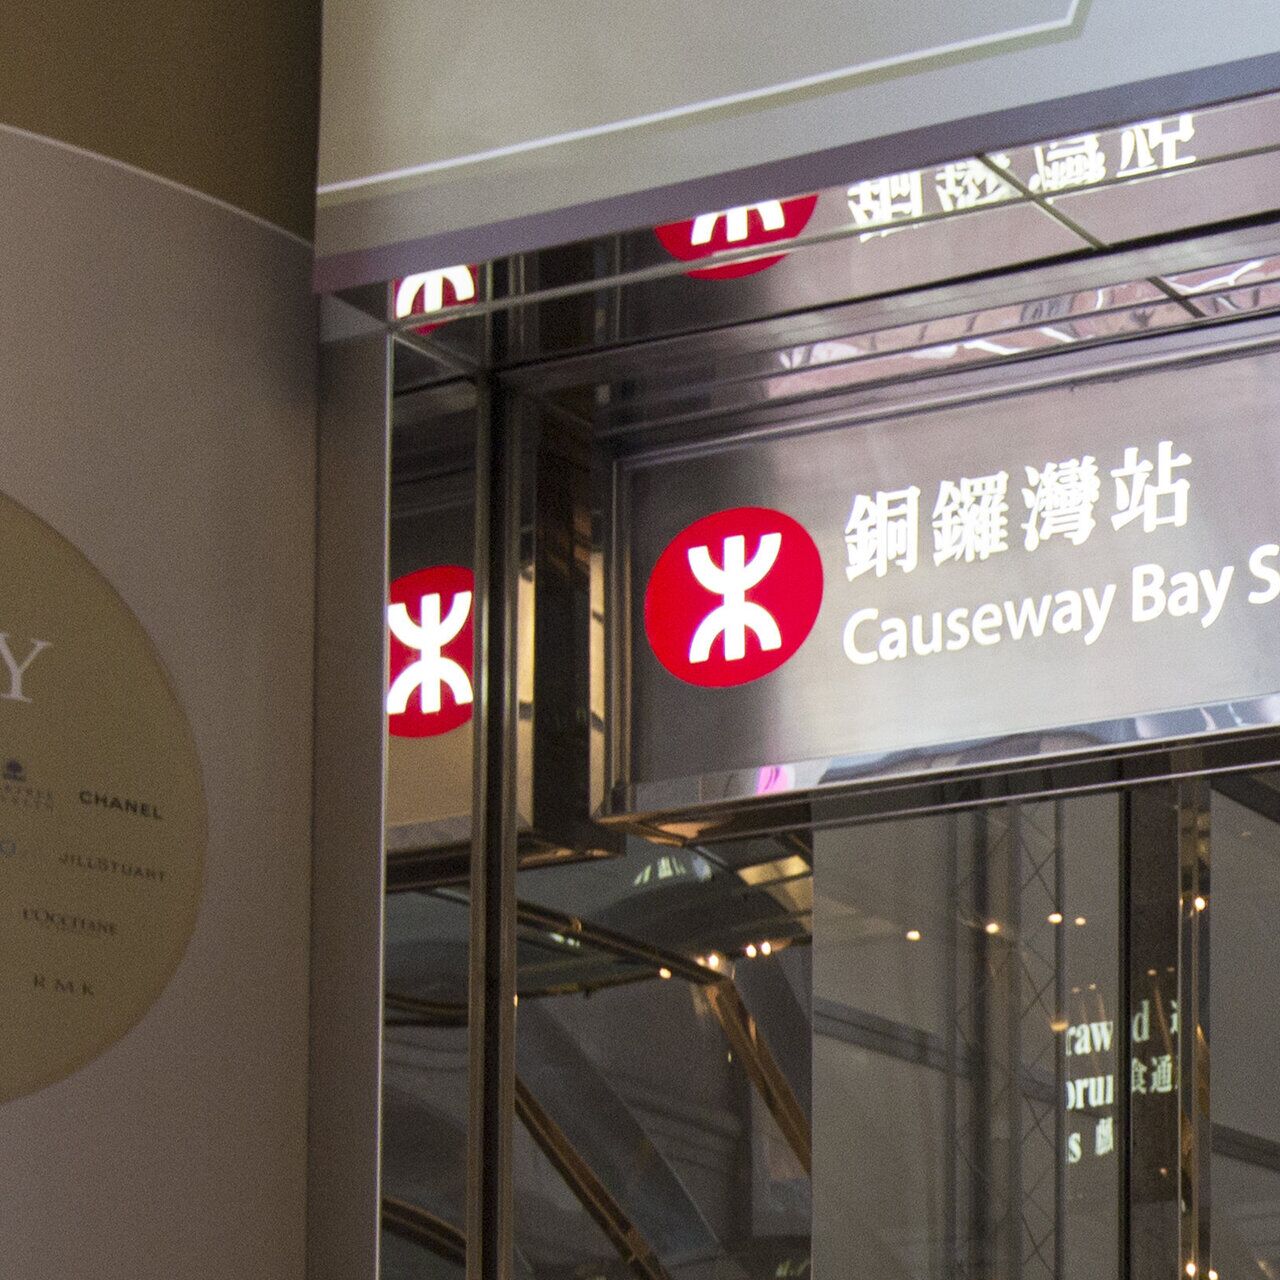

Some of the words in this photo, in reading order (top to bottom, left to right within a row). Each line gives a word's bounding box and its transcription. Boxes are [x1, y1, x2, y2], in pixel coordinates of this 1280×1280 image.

[843, 440, 1193, 582] 銅鑼灣站
[843, 582, 1117, 667] Causeway
[1131, 564, 1235, 629] Bay
[79, 790, 163, 821] CHANEL
